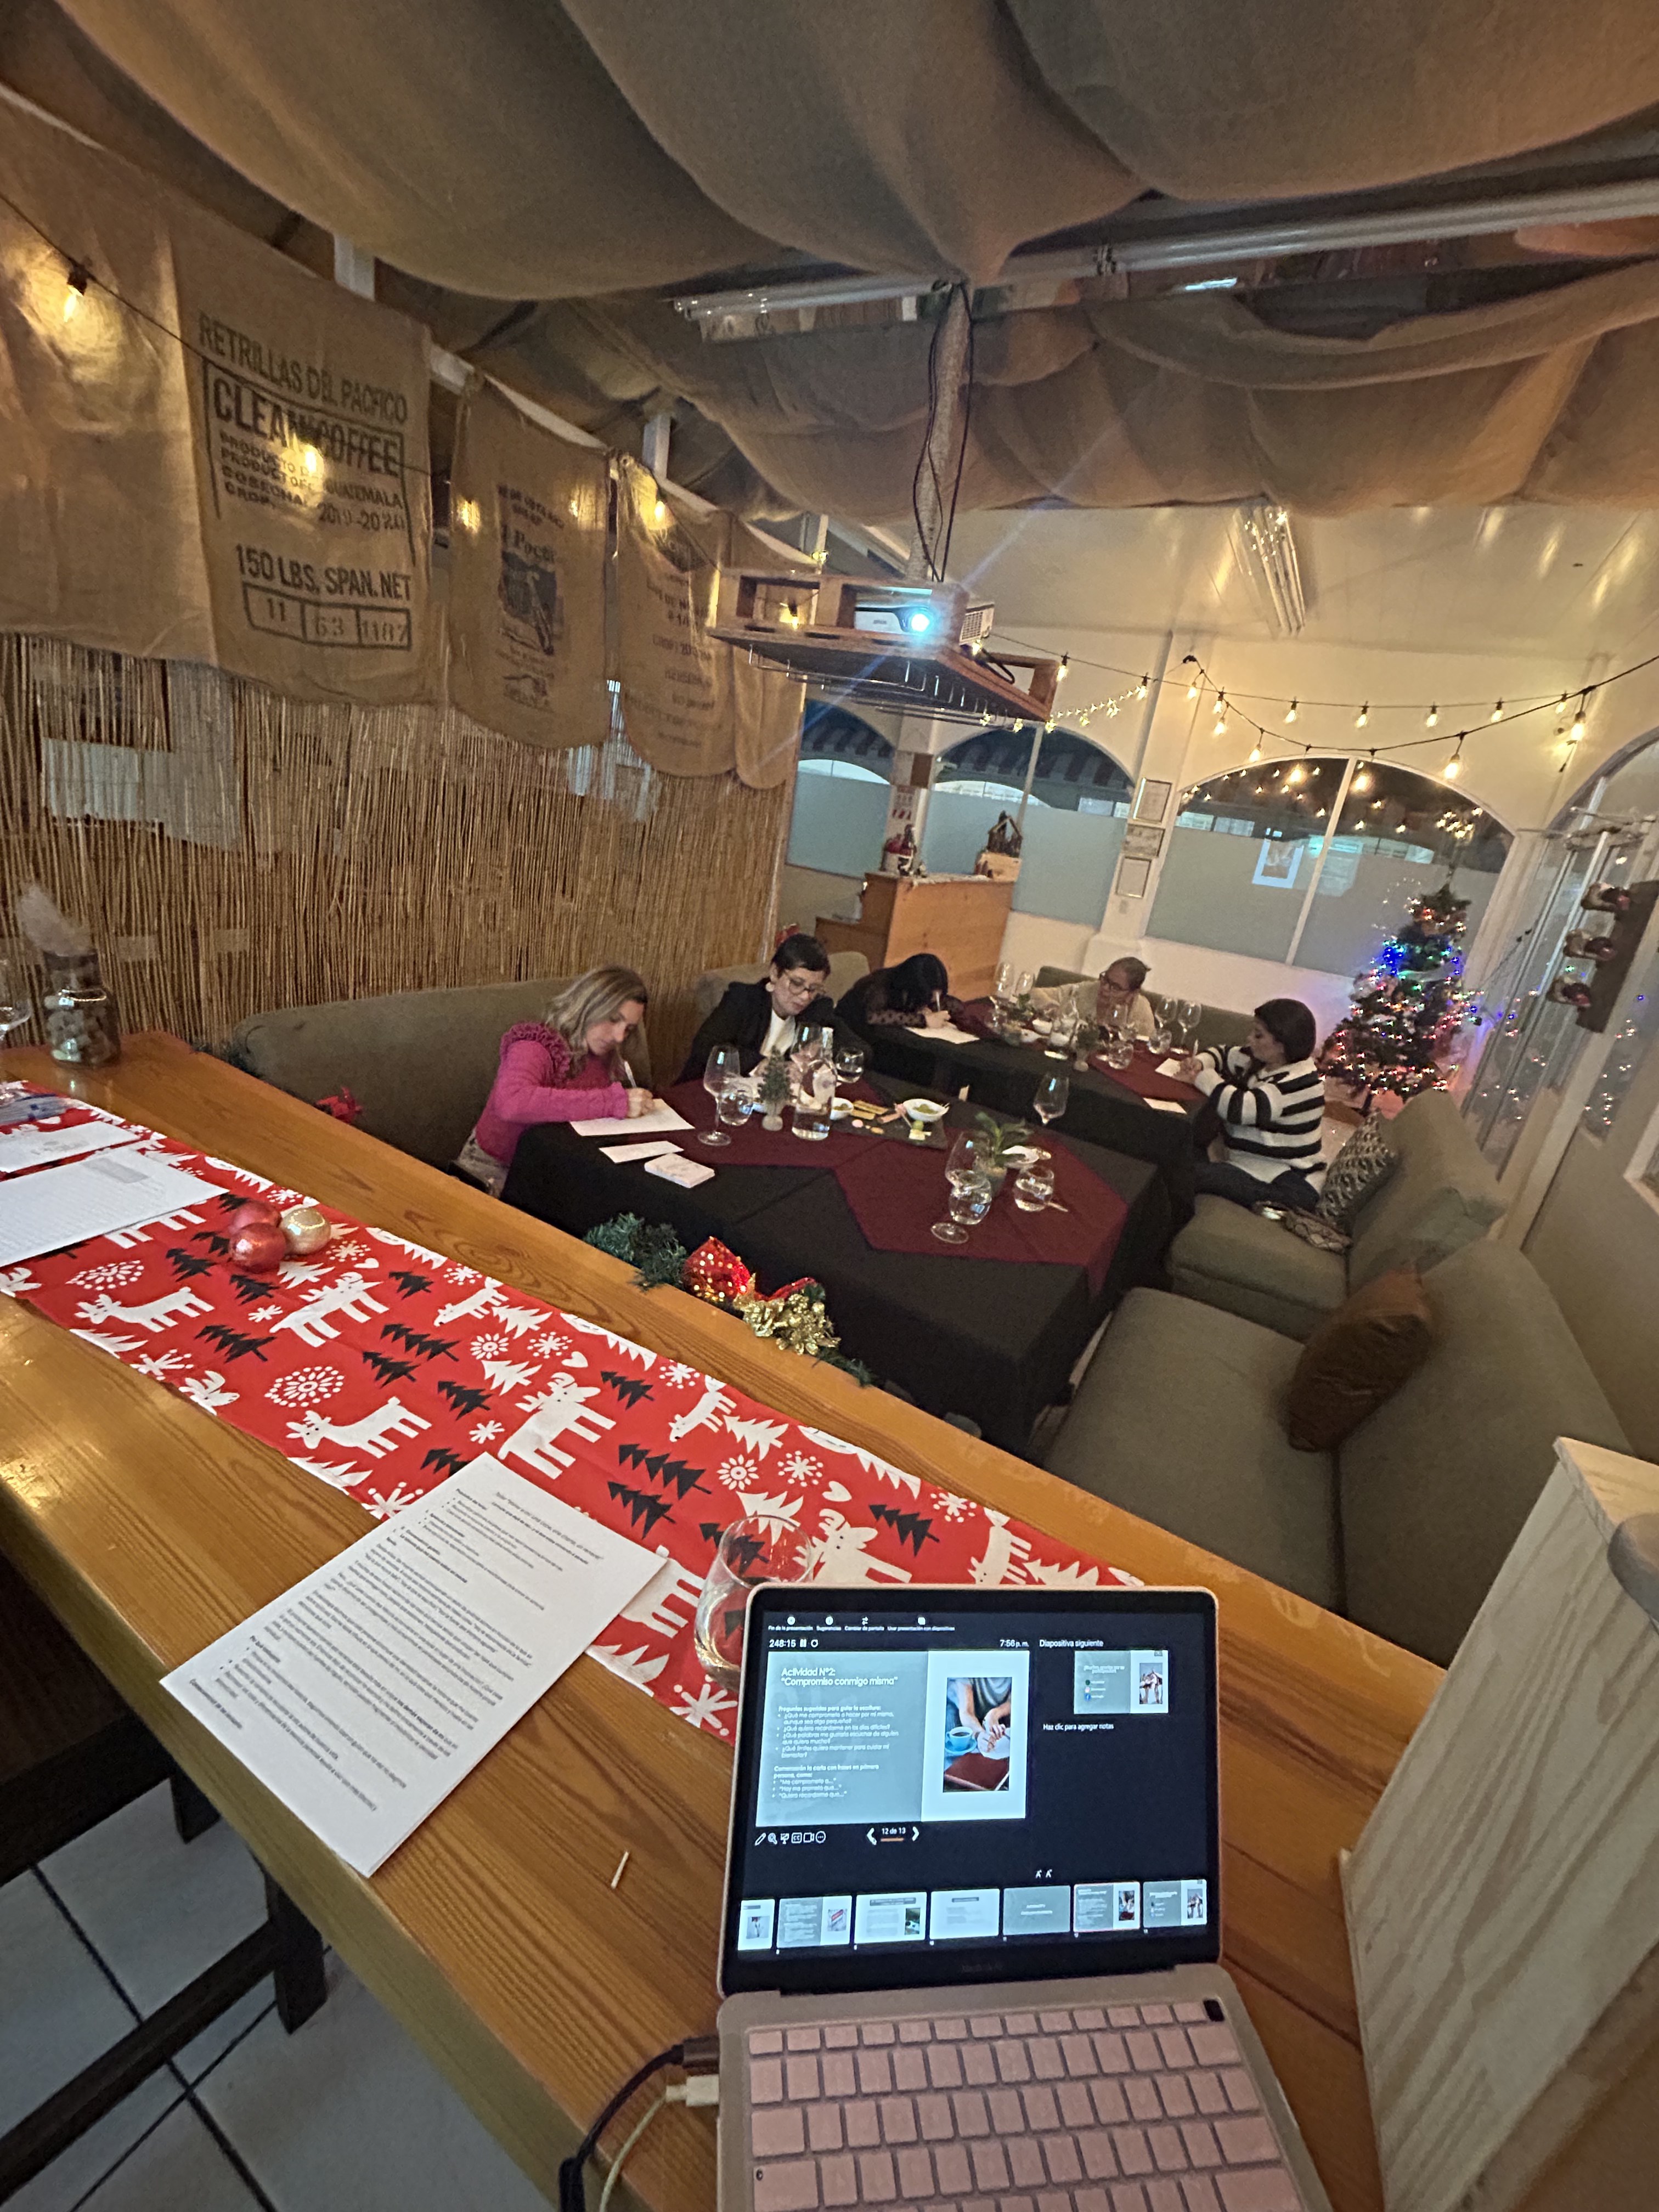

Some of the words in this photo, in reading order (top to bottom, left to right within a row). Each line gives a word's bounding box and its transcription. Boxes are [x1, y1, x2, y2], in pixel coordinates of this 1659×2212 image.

[306, 365, 338, 407] DEL
[236, 543, 274, 582] 150
[325, 566, 379, 597] SPAN.
[379, 570, 413, 601] NET
[1039, 1639, 1074, 1648] Diapositiva
[1075, 1639, 1104, 1648] siguiente
[781, 1667, 818, 1677] Actividad
[834, 1677, 868, 1687] conmigo
